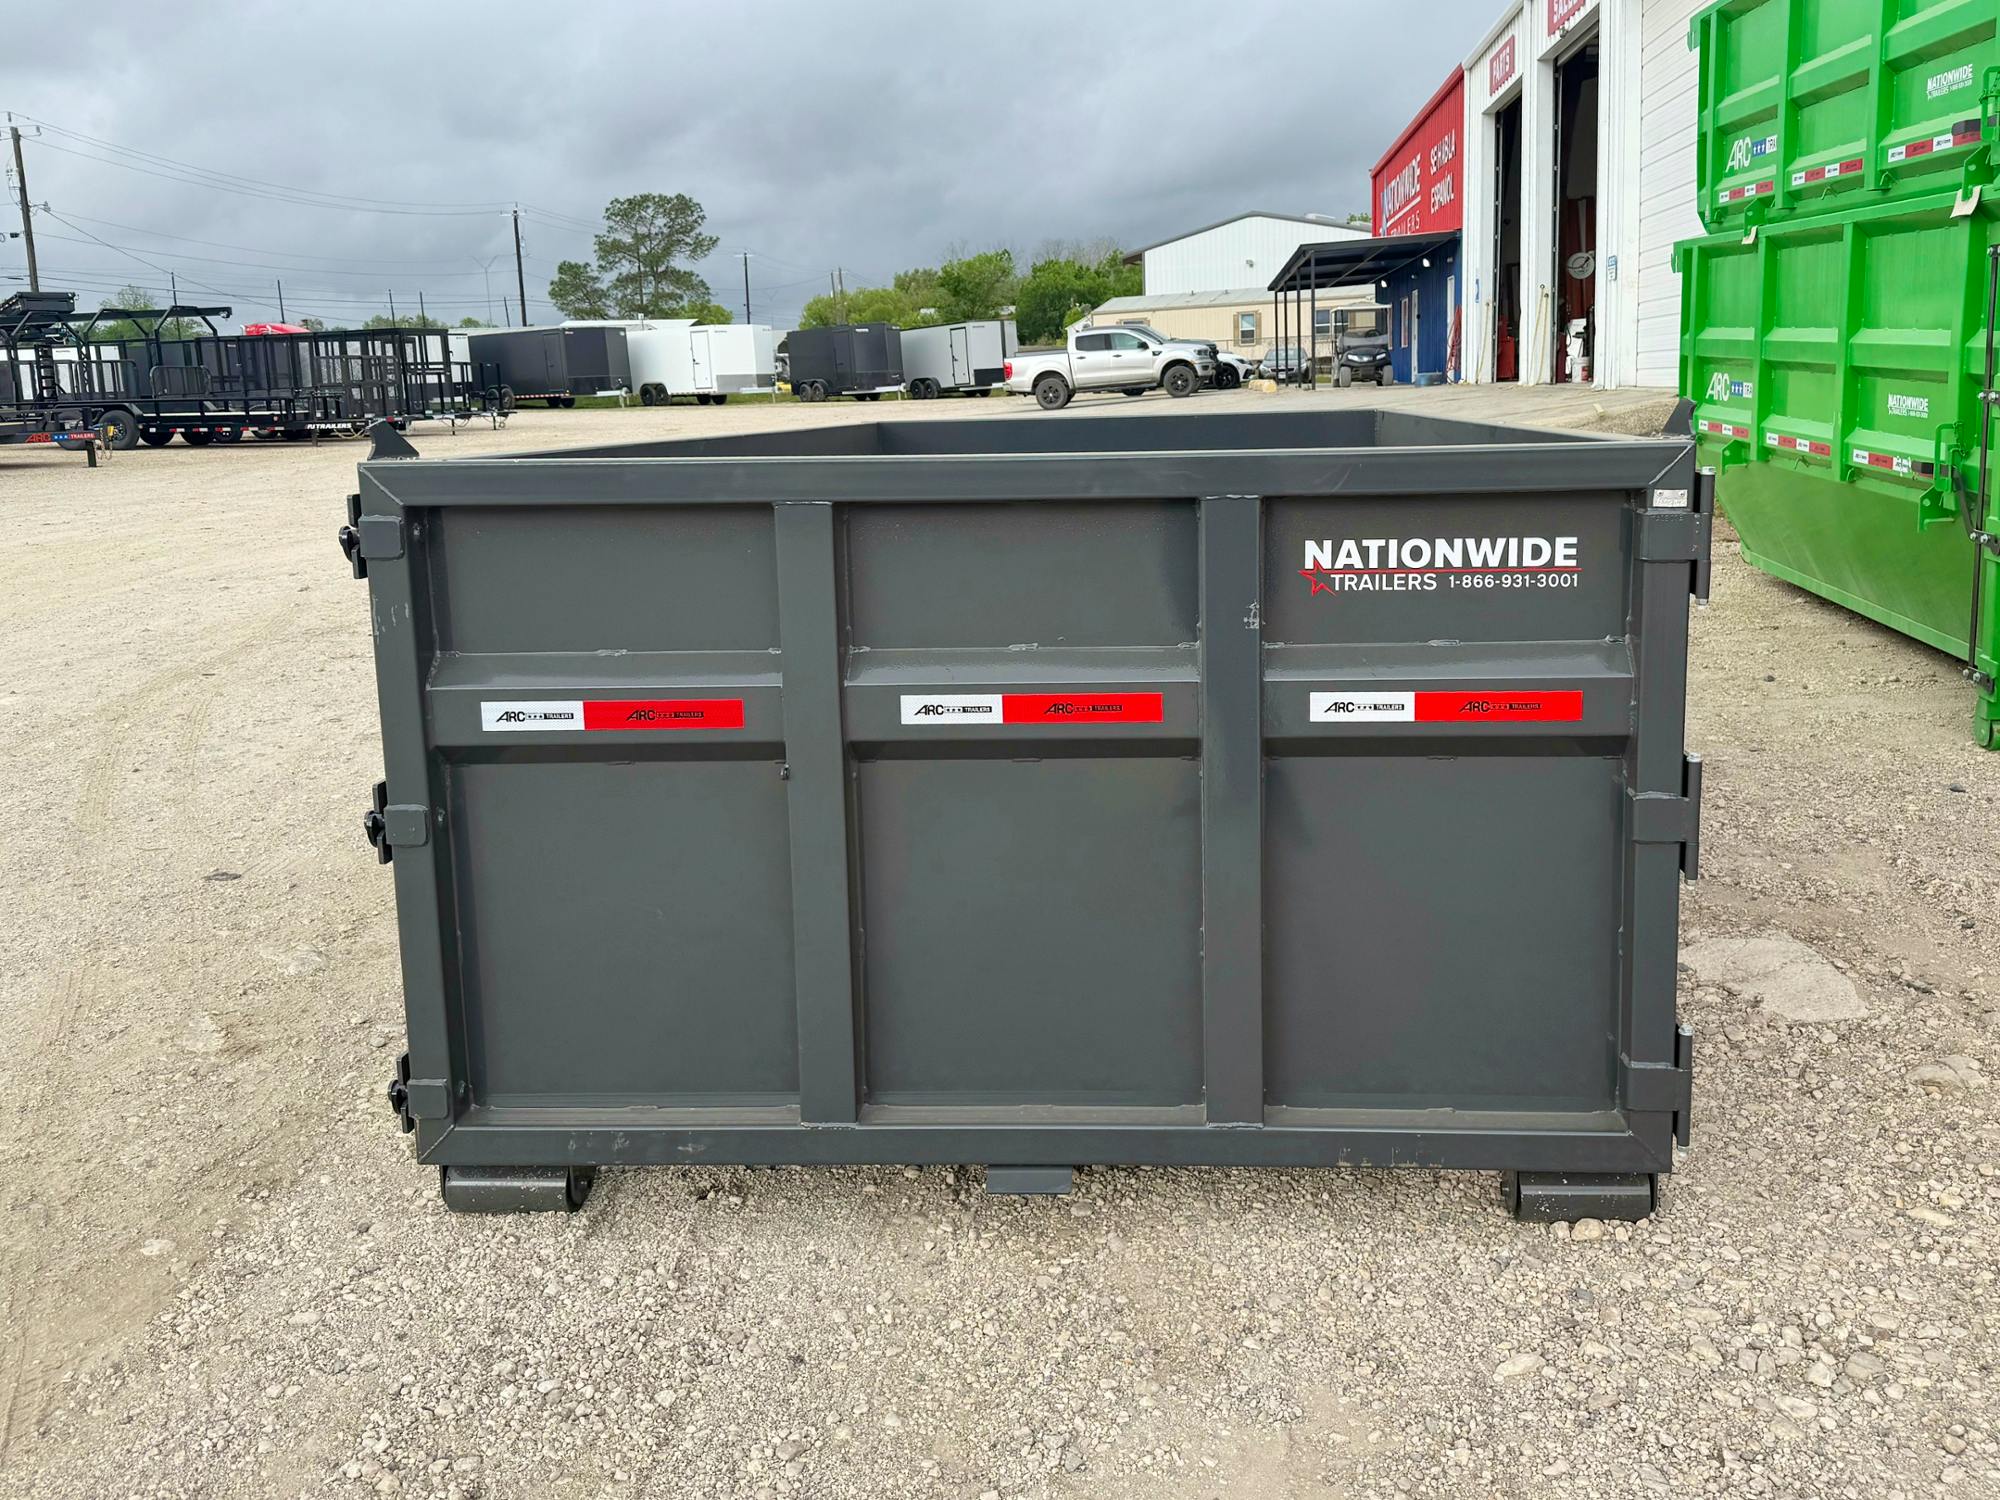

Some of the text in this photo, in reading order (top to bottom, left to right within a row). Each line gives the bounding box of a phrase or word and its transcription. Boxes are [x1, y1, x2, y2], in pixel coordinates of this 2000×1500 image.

[1492, 45, 1510, 85] PARTS
[1927, 64, 1973, 91] NATIONWIDE
[1437, 128, 1456, 171] HABLA
[1725, 136, 1751, 173] ARC
[1383, 152, 1421, 218] NATIONWIDE
[1705, 372, 1730, 402] ARC
[1888, 394, 1928, 411] NATIONWIDE
[25, 432, 51, 443] ARC
[1304, 537, 1578, 569] NATIONWIDE
[1331, 573, 1578, 591] TRAILERS 1-866-931-3001
[626, 709, 704, 721] ARC TRAILERS
[914, 704, 944, 716] ARC
[1044, 703, 1074, 715] ARC
[1324, 702, 1355, 713] ARC
[1459, 701, 1489, 713] ARC
[496, 711, 526, 722] ARC
